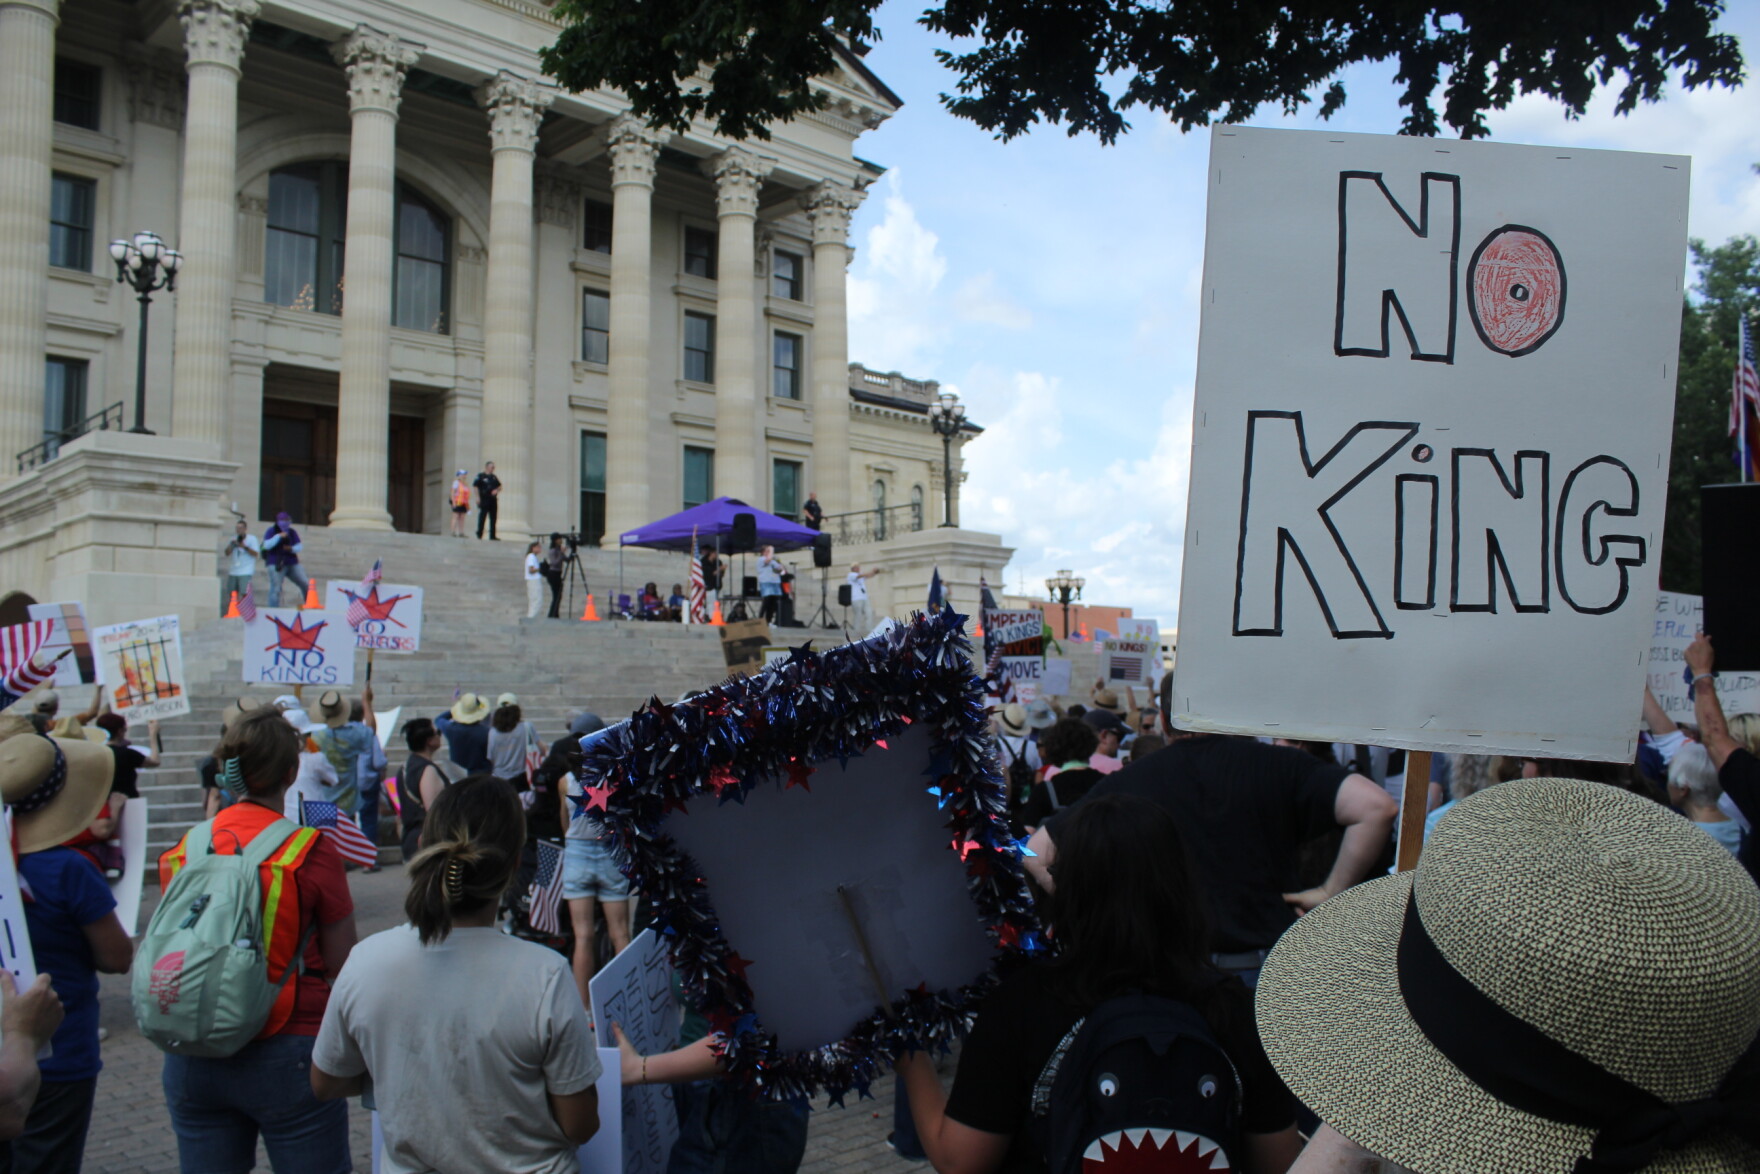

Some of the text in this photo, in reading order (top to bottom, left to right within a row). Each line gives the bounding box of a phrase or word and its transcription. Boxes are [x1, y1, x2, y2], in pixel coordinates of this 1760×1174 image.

[1334, 170, 1568, 367] NO
[1005, 620, 1041, 642] KINGS
[274, 649, 325, 668] NO
[260, 665, 337, 684] KINGS
